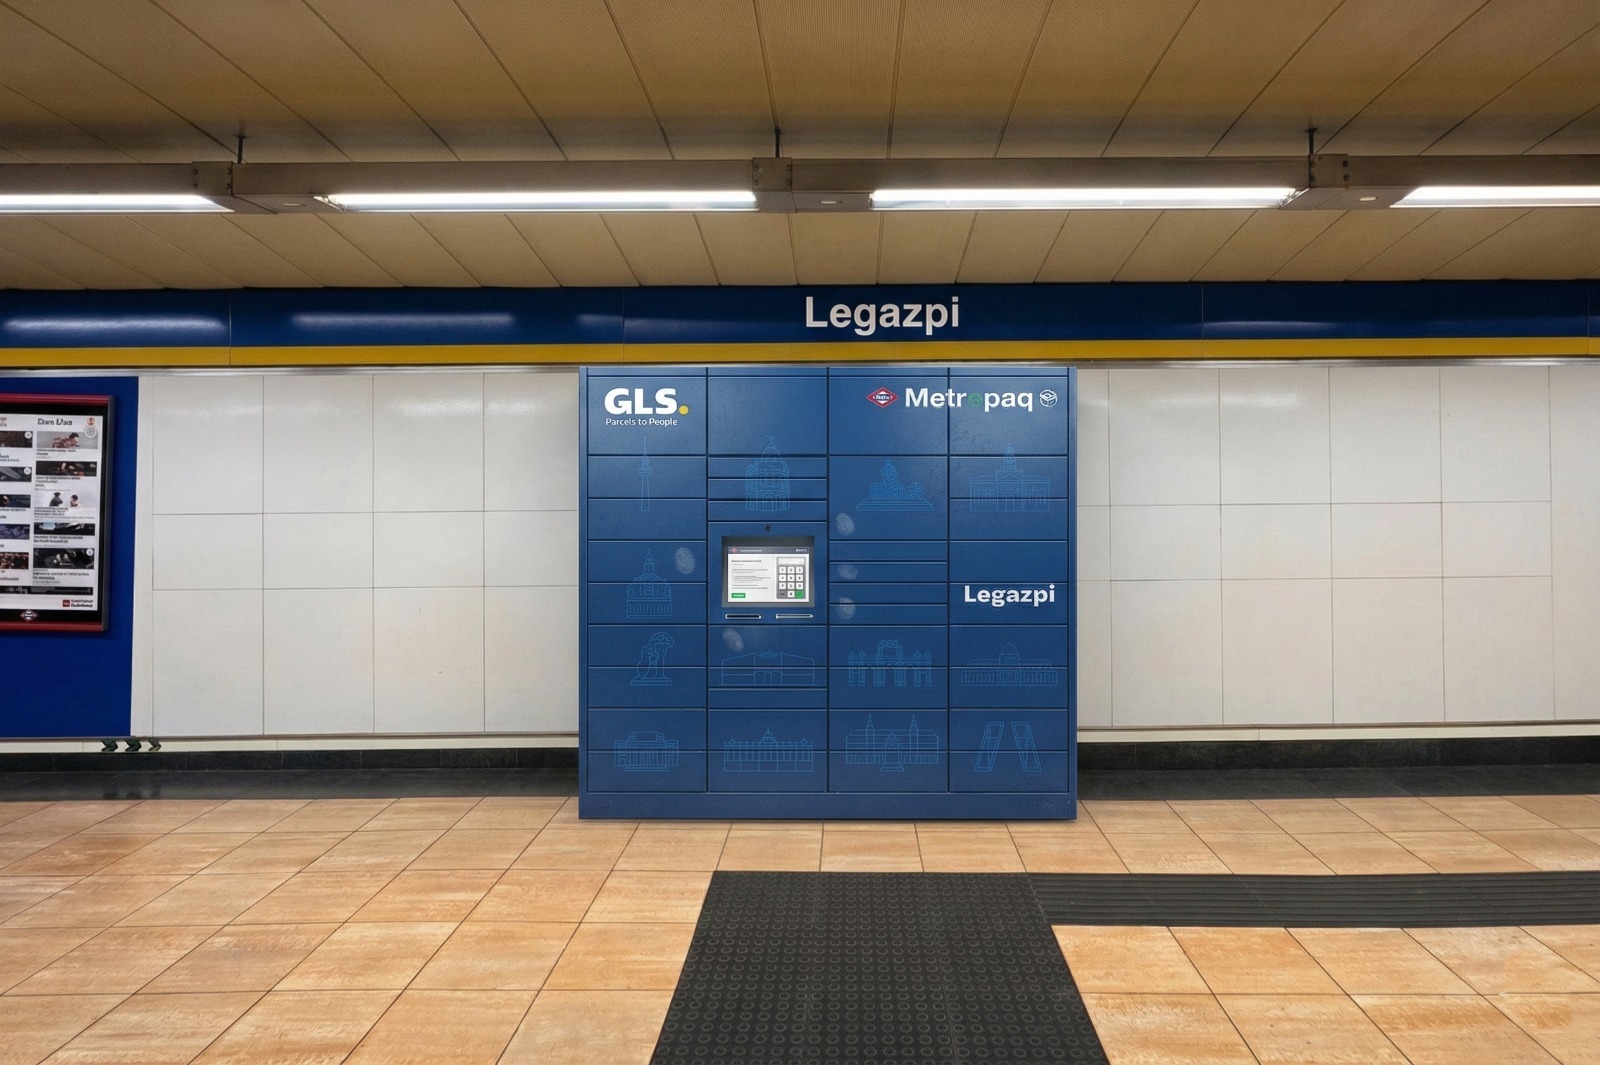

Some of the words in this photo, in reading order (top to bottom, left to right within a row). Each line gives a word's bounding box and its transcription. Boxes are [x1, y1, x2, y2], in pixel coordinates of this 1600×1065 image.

[805, 296, 959, 336] Legazpi
[605, 417, 636, 426] Parcels
[638, 417, 648, 426] to
[648, 417, 678, 427] People
[964, 583, 1055, 607] Legazpi
